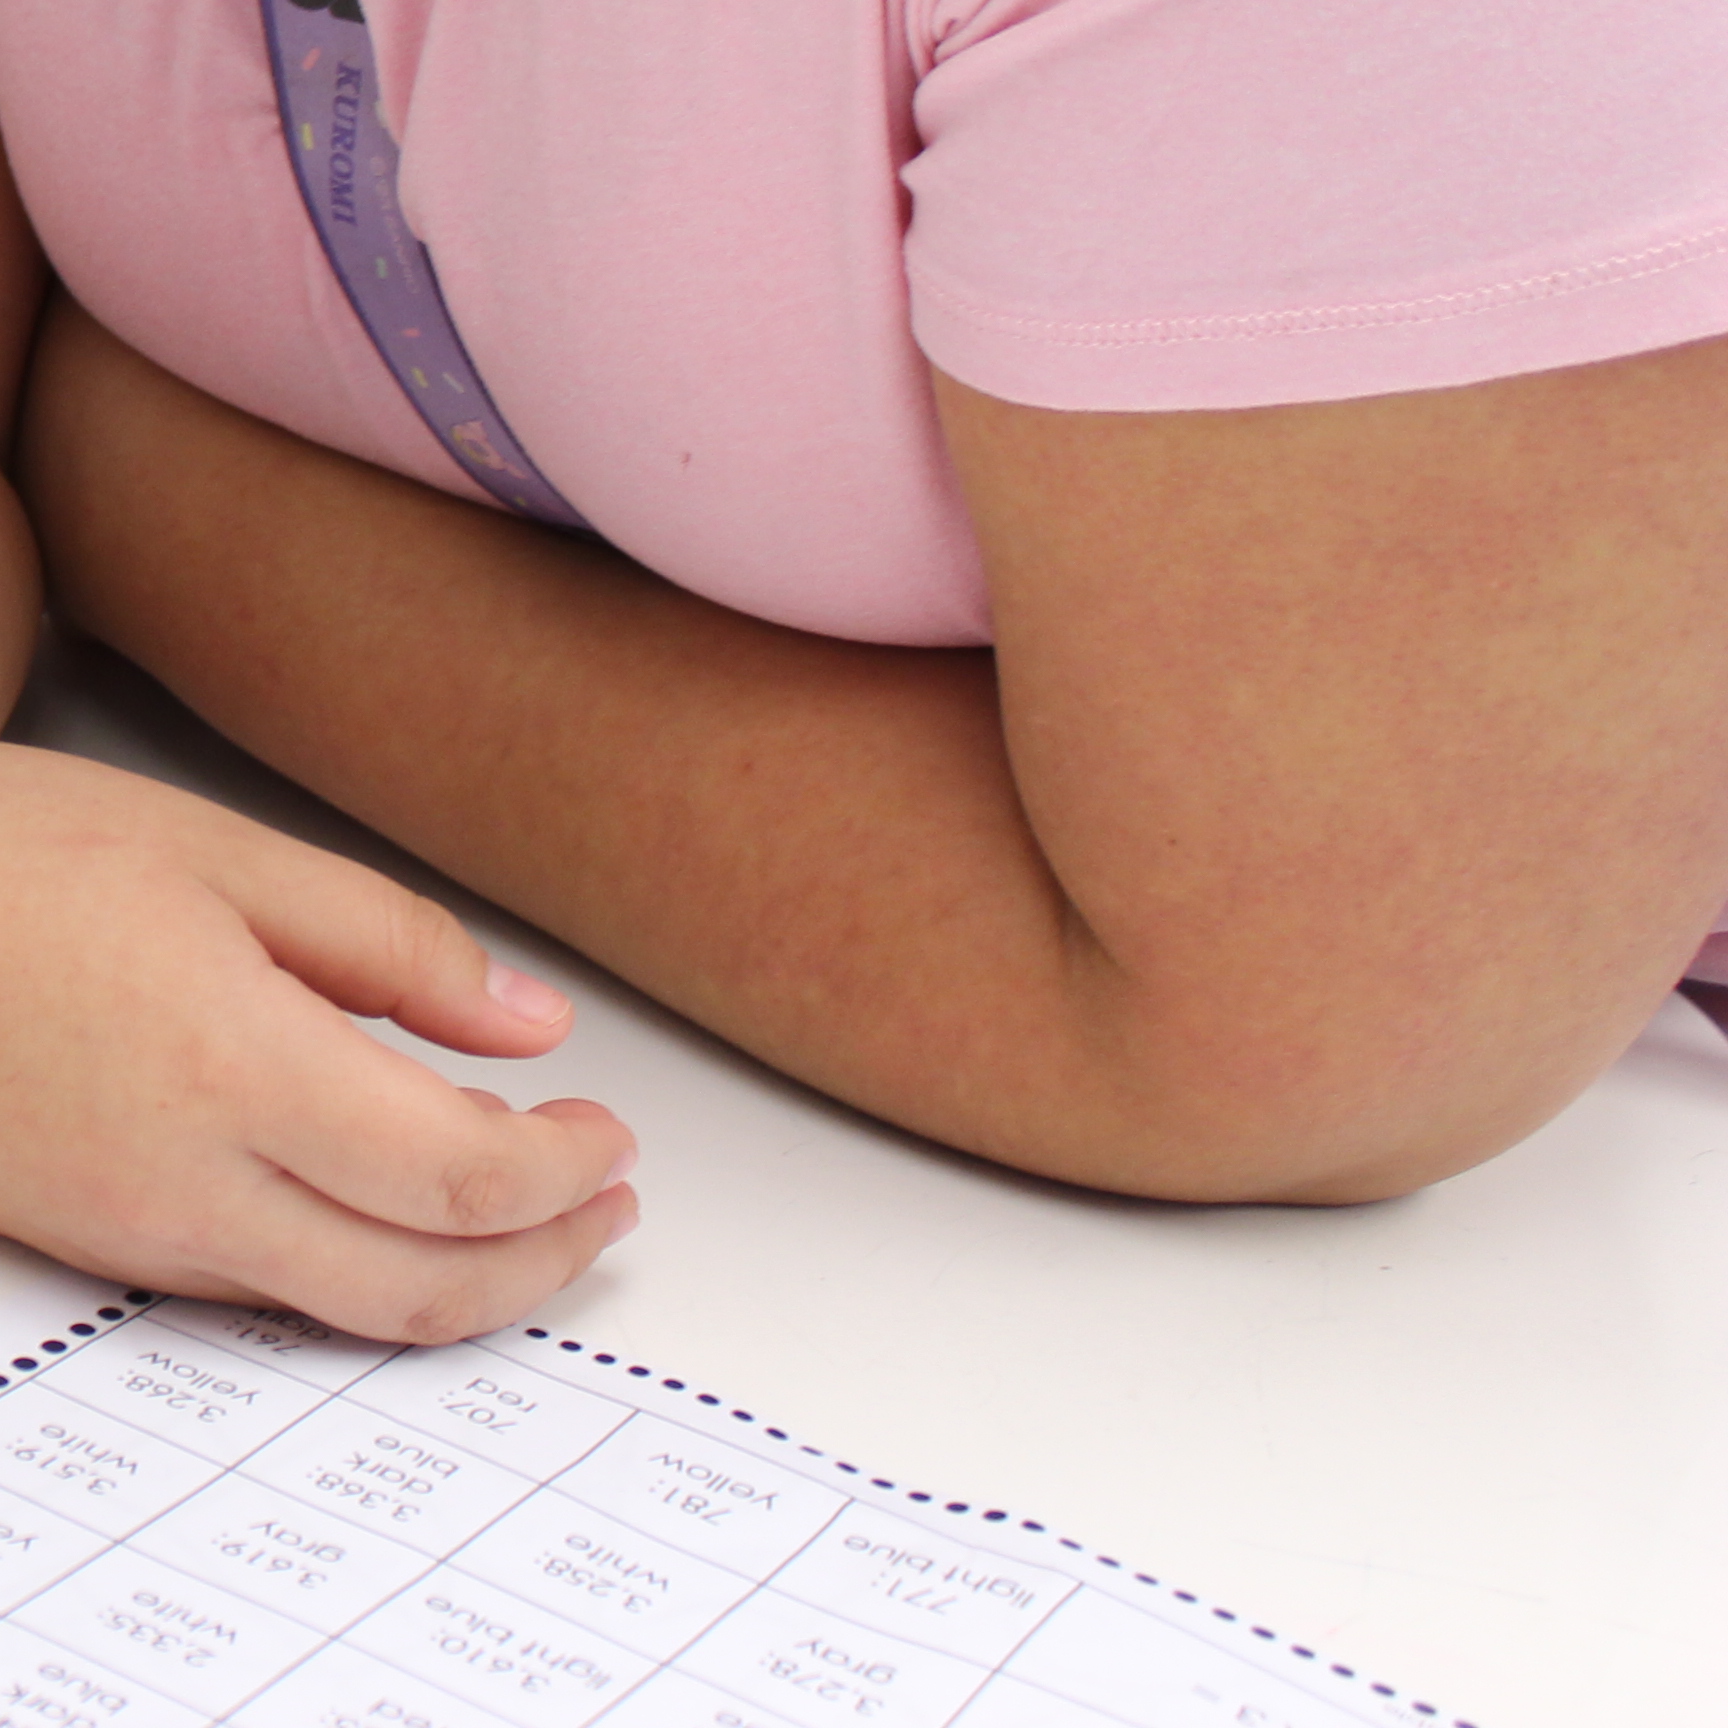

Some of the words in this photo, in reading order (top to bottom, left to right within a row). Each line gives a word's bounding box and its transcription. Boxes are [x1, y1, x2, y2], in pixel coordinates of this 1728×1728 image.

[328, 60, 362, 227] KUROMI
[138, 1350, 261, 1406] yellow
[466, 1377, 538, 1413] red
[439, 1390, 518, 1435] 707:
[39, 1423, 139, 1476] white
[344, 1451, 434, 1496] dark
[374, 1434, 460, 1479] blue
[646, 1452, 780, 1511] yellow
[648, 1479, 731, 1526] 781:
[249, 1519, 346, 1564] gray
[564, 1533, 670, 1592] white
[843, 1534, 935, 1573] blue
[870, 1571, 958, 1614] 771:
[944, 1565, 1037, 1610] light
[131, 1591, 236, 1645] white
[425, 1596, 513, 1646] blue
[520, 1640, 612, 1691] light
[794, 1637, 899, 1685] gray
[37, 1662, 128, 1715] blue
